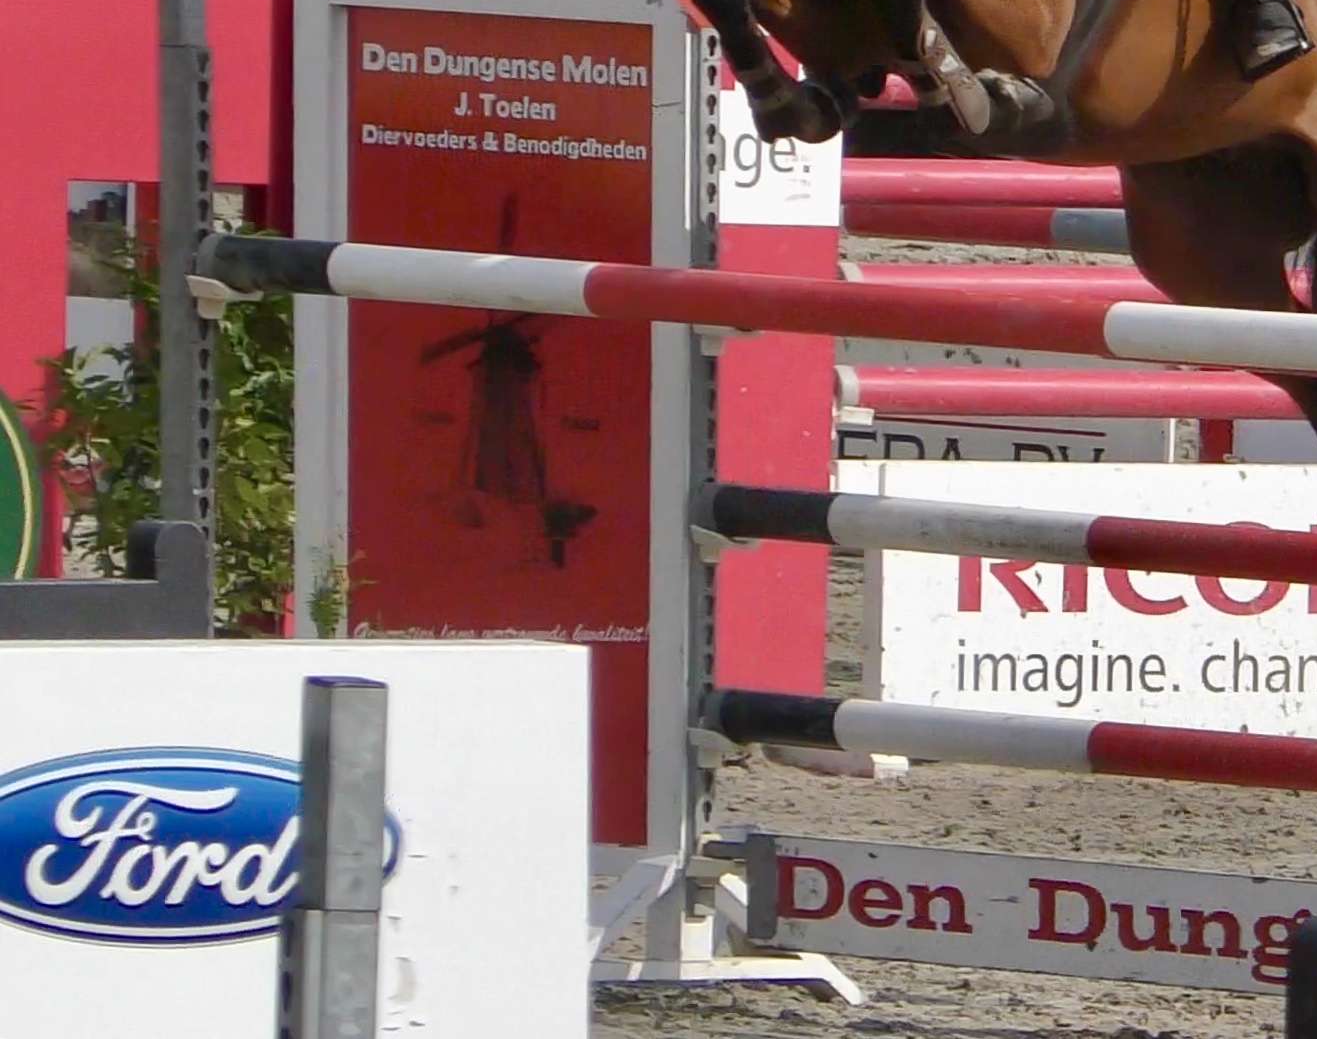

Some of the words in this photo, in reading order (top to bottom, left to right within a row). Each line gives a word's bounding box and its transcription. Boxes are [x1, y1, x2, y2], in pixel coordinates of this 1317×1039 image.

[361, 42, 417, 74] Den
[423, 47, 556, 82] Dungense
[562, 54, 648, 87] Molen
[454, 92, 472, 117] J.
[478, 93, 556, 121] Toelen
[361, 124, 478, 151] Diervoeders
[482, 131, 499, 152] &
[503, 133, 648, 160] Benodigdheden
[957, 638, 1181, 708] imagine.
[25, 779, 301, 907] Ford
[775, 855, 974, 935] Den
